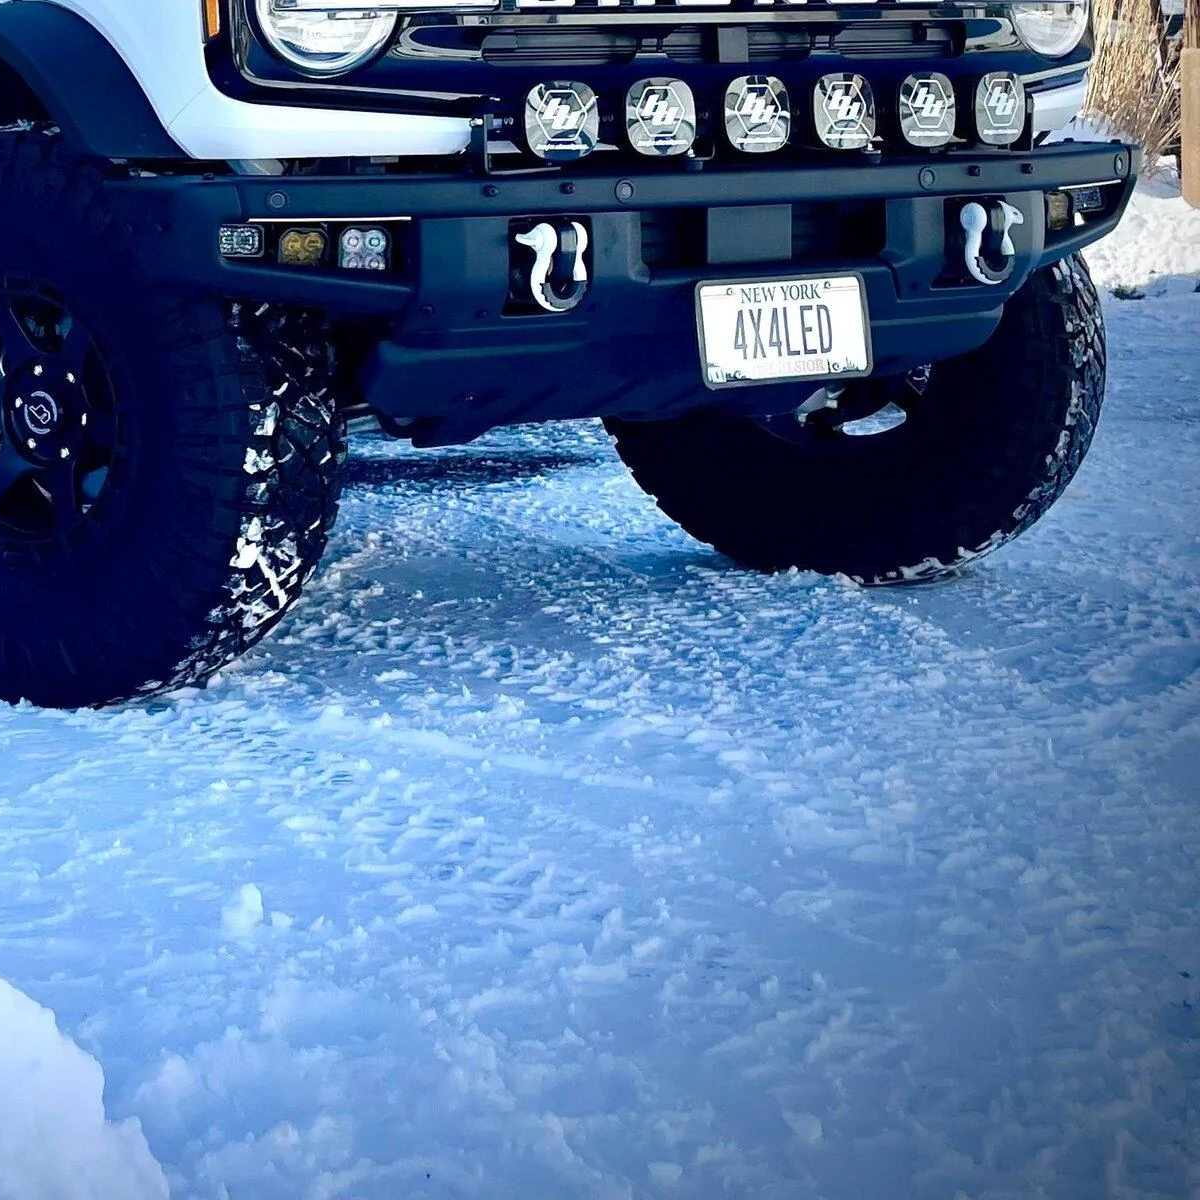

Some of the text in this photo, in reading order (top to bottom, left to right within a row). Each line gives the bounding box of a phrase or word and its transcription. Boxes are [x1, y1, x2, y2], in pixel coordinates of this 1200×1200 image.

[740, 281, 822, 304] NEW YORK
[733, 304, 833, 360] 4X4LED
